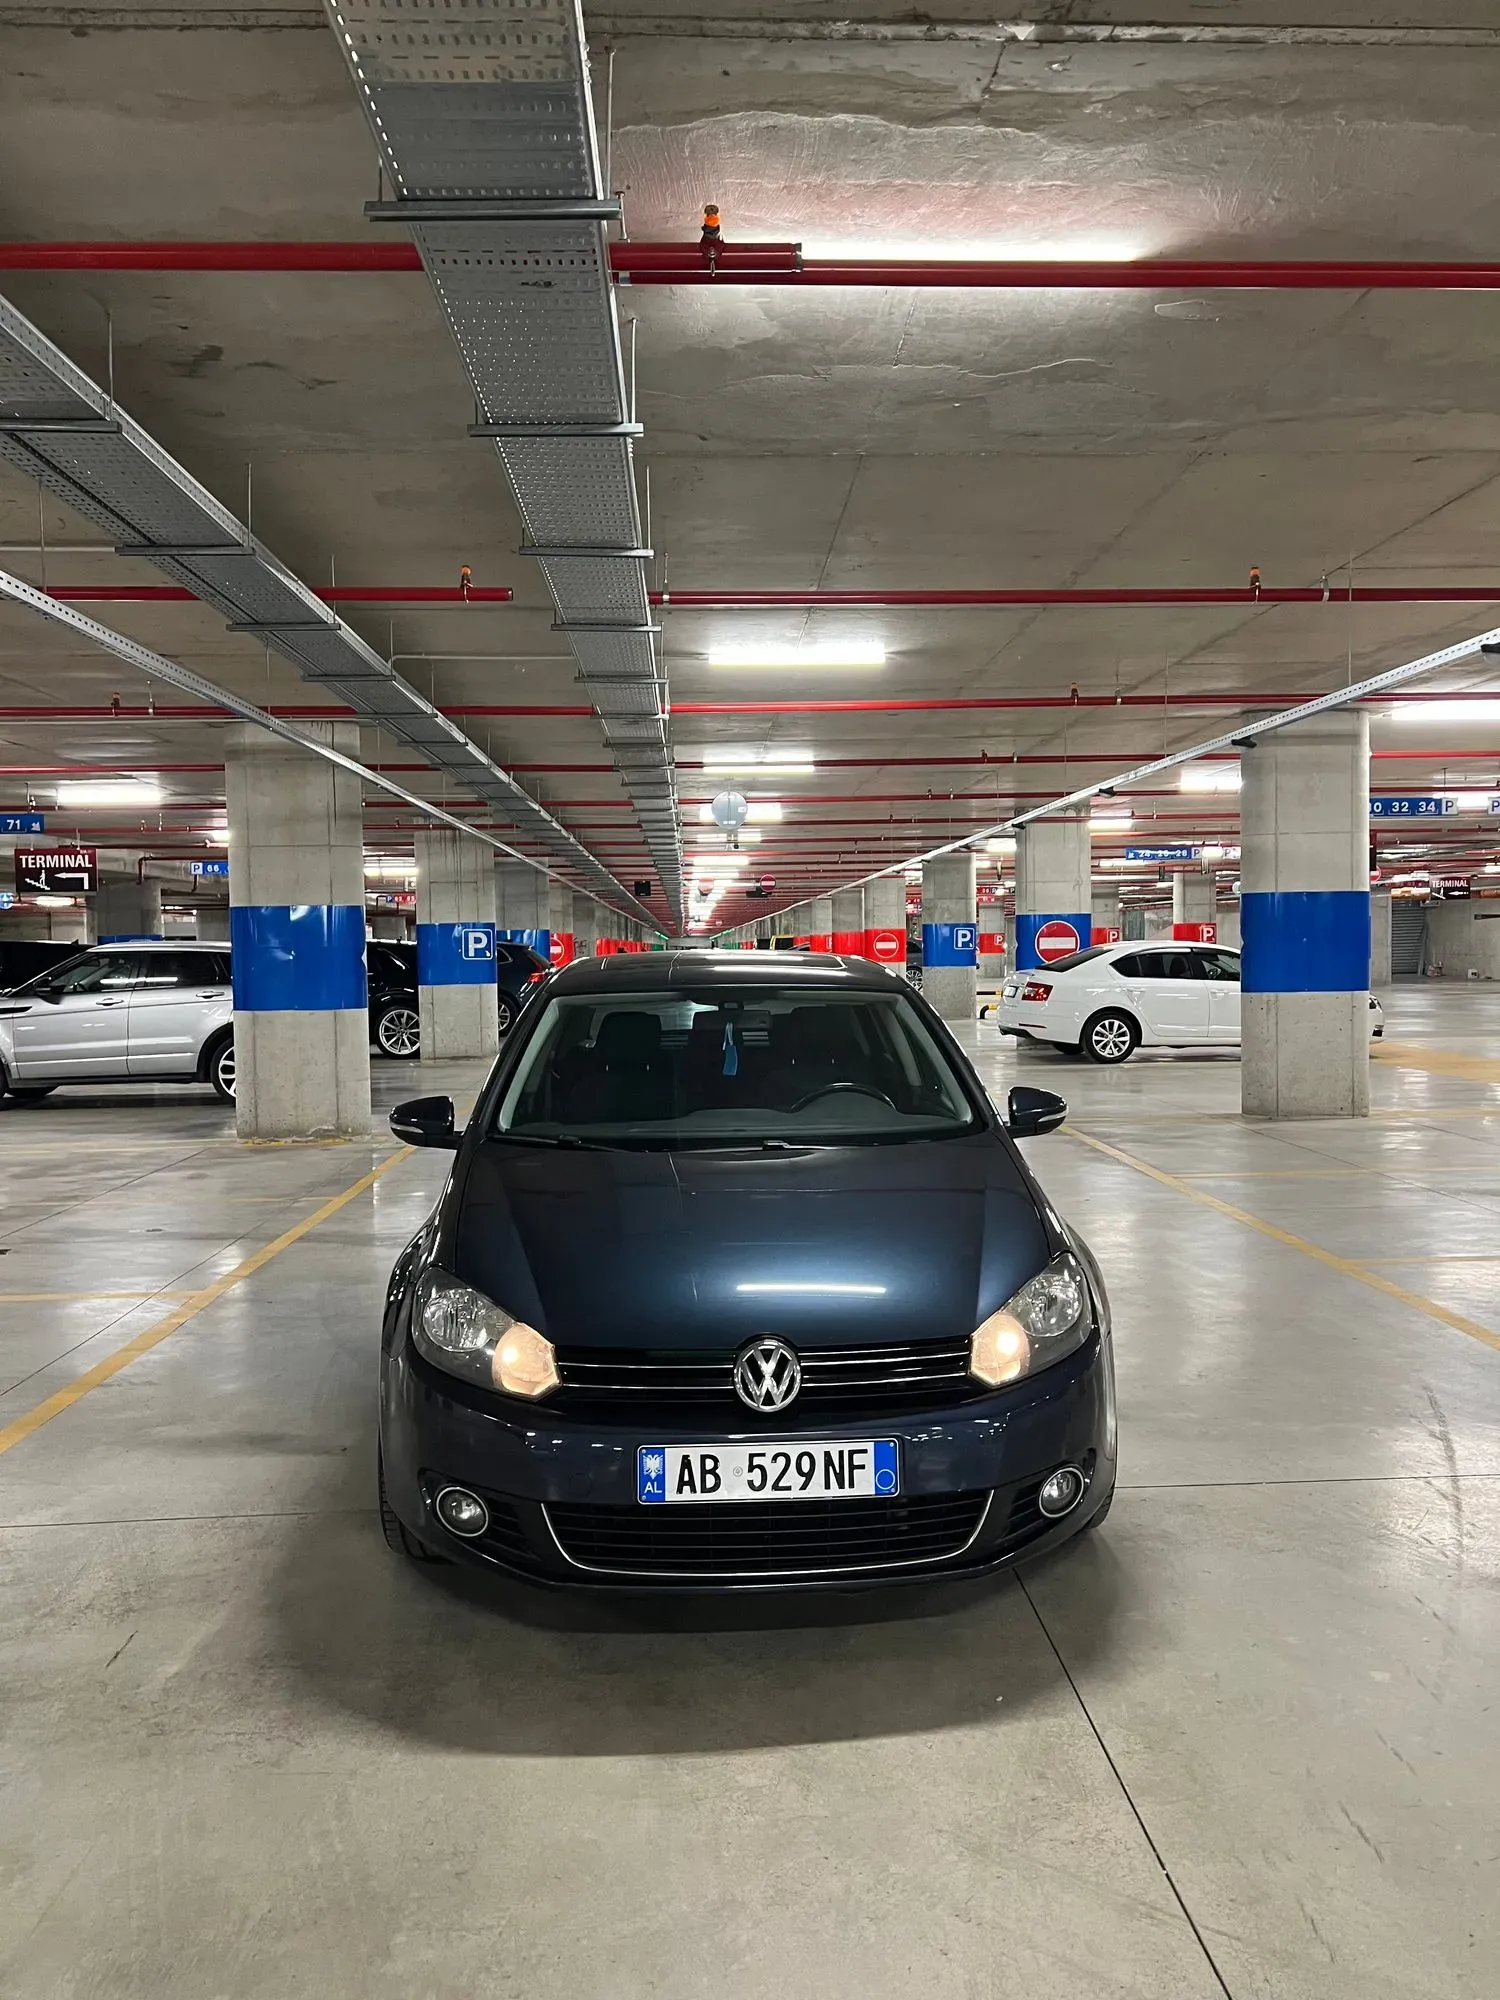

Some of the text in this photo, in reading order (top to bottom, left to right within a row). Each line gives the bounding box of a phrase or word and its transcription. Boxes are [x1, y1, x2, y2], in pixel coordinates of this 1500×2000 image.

[1369, 801, 1454, 812] 0 32 34 P
[7, 819, 21, 830] 71
[1194, 849, 1200, 858] P
[19, 854, 93, 868] TERMINAL
[193, 864, 200, 873] P
[1431, 879, 1469, 889] TERMINAL
[957, 930, 971, 947] P
[996, 935, 1003, 944] P
[1109, 931, 1118, 942] P
[1203, 926, 1214, 942] P
[468, 932, 488, 957] P
[676, 1454, 722, 1494] AB
[643, 1481, 663, 1494] AL
